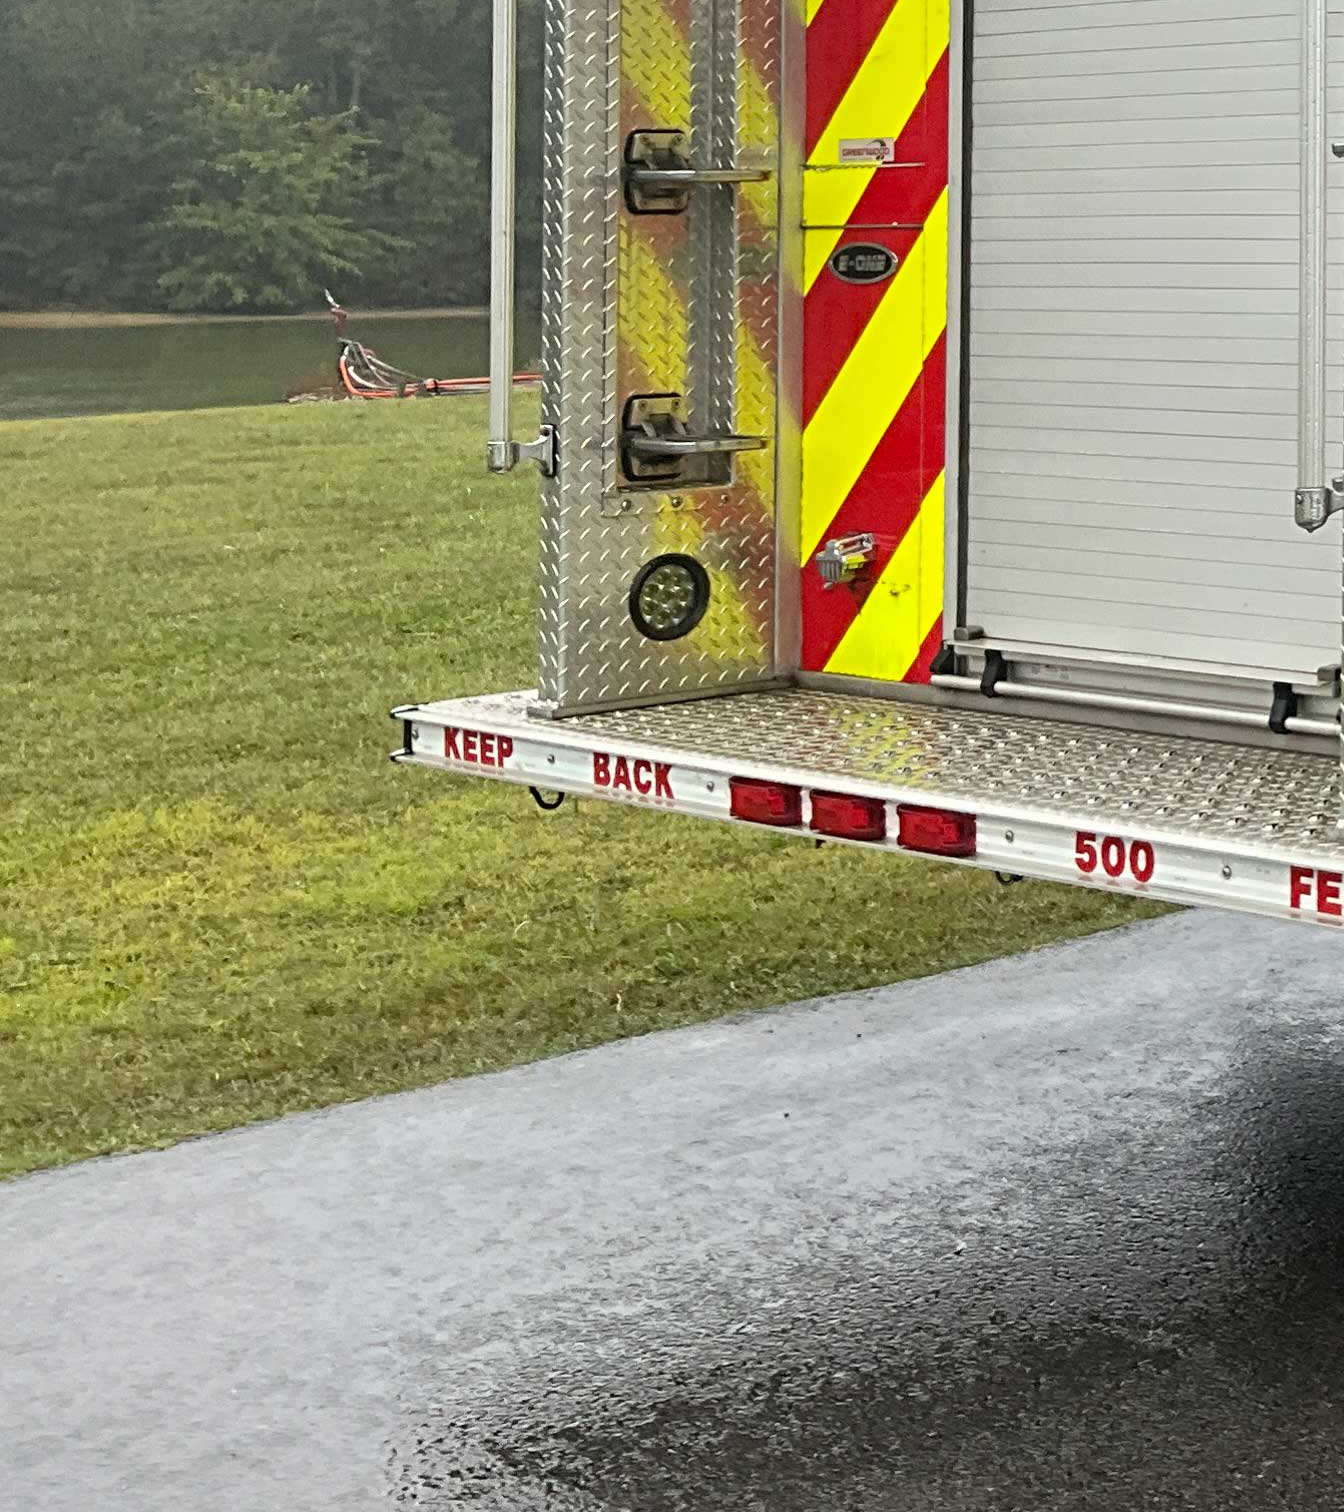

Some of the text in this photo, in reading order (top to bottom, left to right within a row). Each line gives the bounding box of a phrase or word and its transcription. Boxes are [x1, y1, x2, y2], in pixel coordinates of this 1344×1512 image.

[838, 254, 886, 272] E-ONE
[443, 726, 514, 769] KEEP
[593, 752, 675, 800] BACK
[1075, 830, 1155, 883] 500
